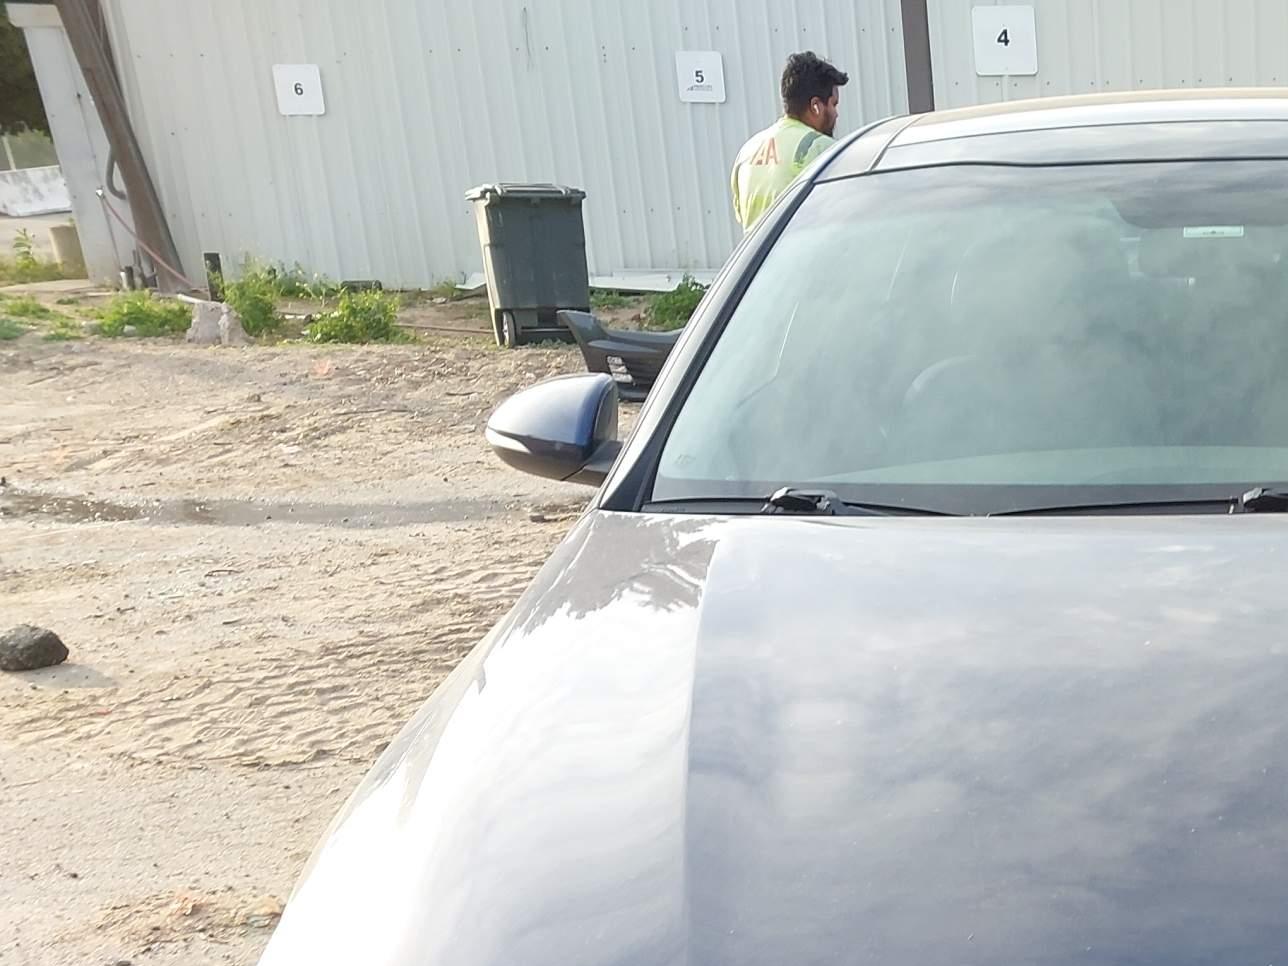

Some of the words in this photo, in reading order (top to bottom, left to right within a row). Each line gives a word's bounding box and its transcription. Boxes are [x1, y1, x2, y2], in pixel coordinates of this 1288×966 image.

[997, 28, 1010, 47] 4
[695, 70, 705, 84] 5
[294, 82, 304, 96] 6
